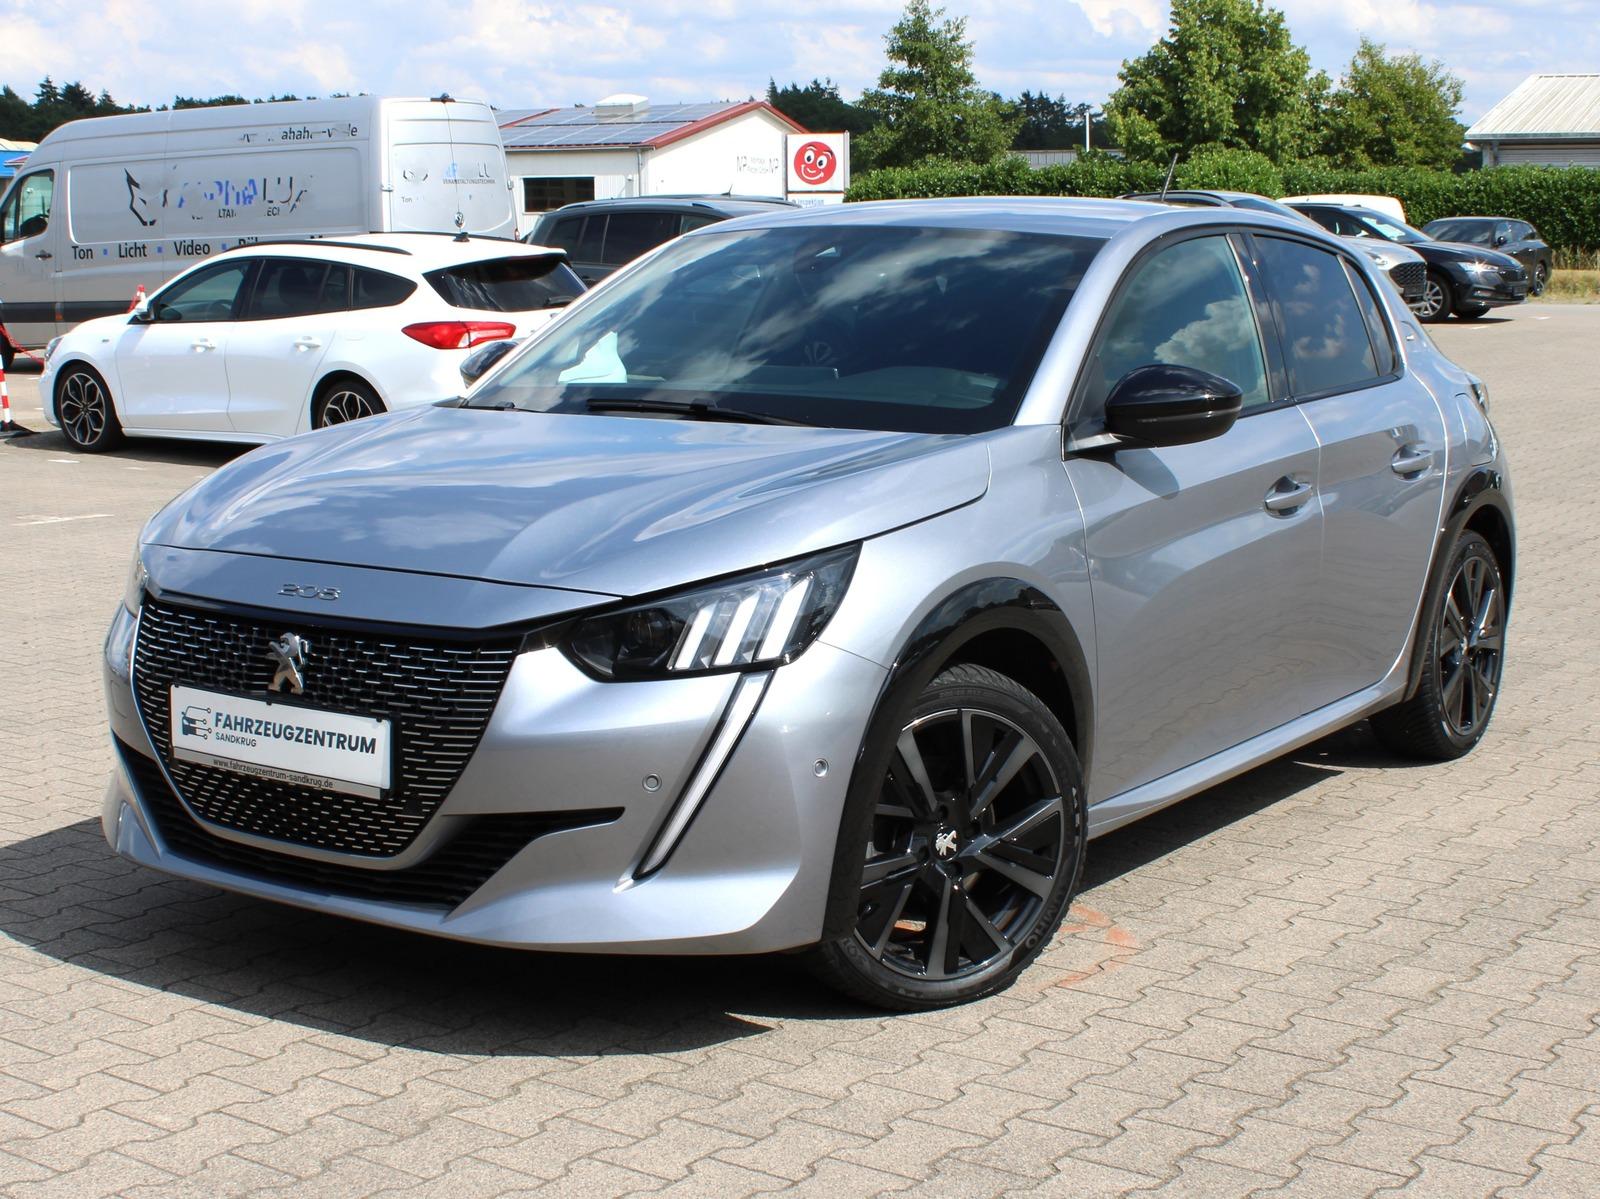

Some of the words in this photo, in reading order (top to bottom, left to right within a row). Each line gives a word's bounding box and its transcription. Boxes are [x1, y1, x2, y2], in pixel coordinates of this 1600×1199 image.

[71, 245, 94, 260] Ton
[118, 243, 148, 258] Licht
[174, 241, 211, 256] Video
[277, 583, 342, 601] 208
[214, 711, 377, 755] FAHRZEUGZENTRUM
[215, 731, 257, 748] SANDKRUG
[213, 758, 334, 789] www.fahrzeugzentrum-sandkrug.de
